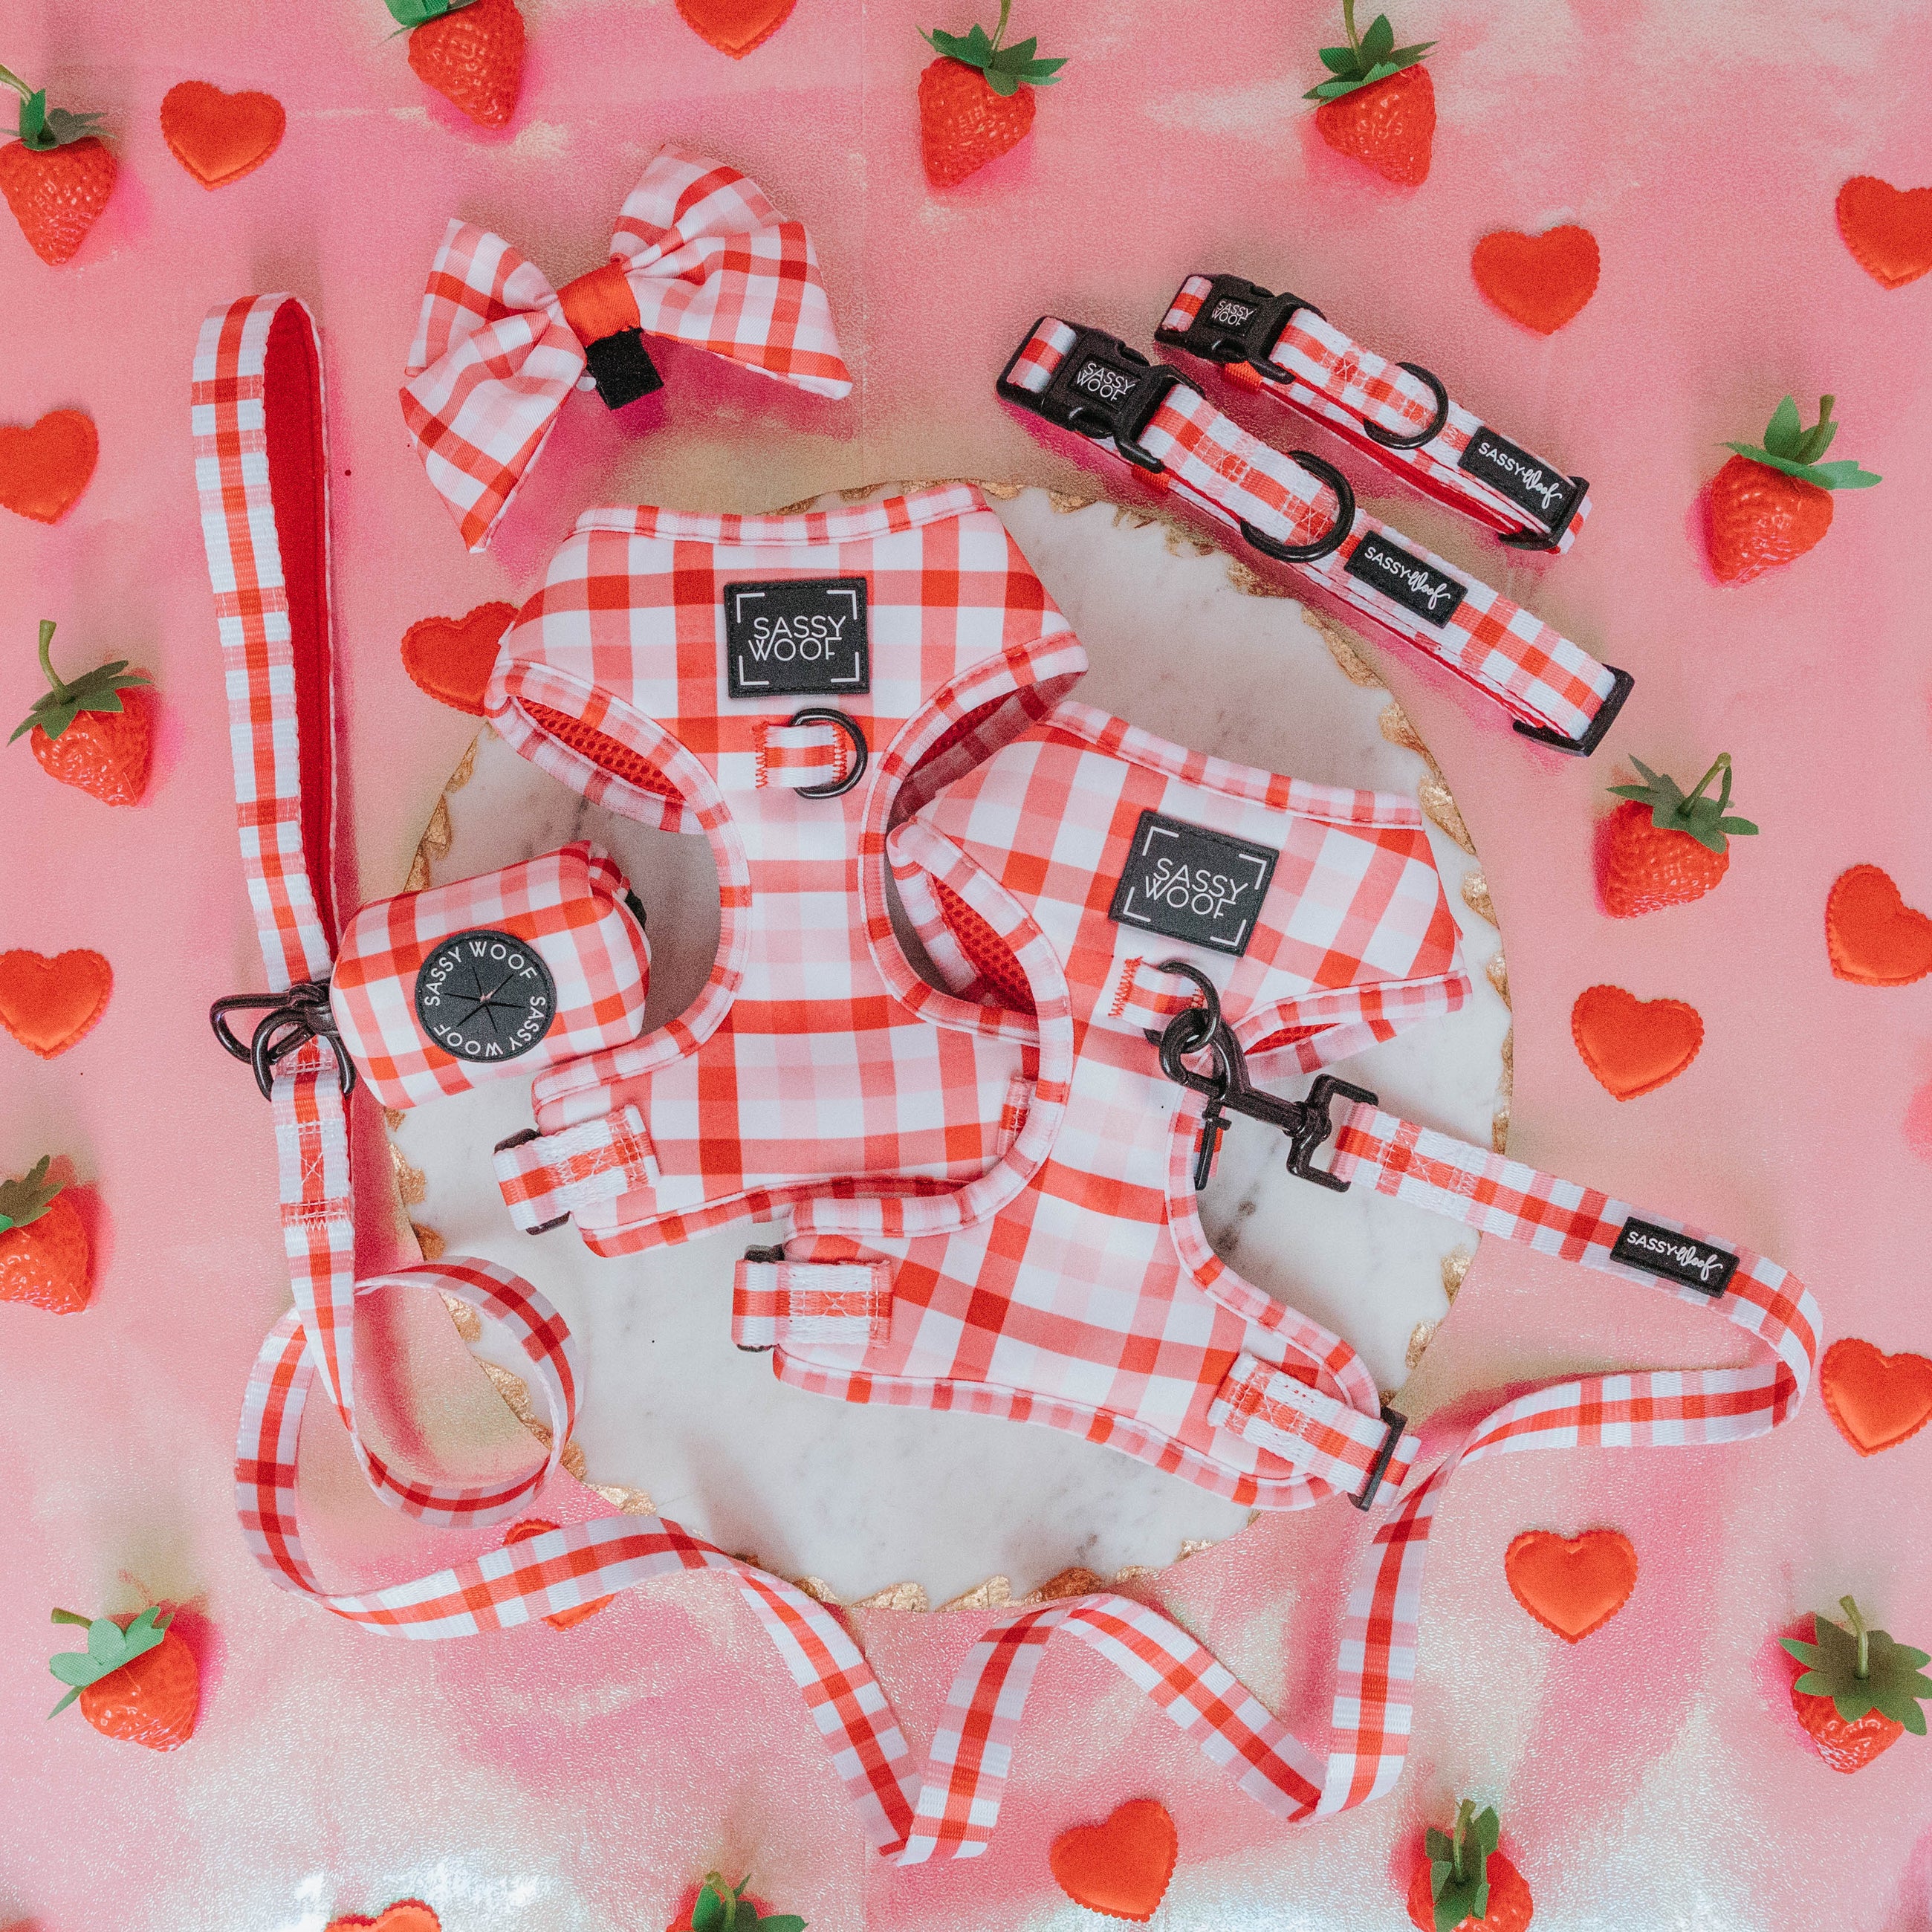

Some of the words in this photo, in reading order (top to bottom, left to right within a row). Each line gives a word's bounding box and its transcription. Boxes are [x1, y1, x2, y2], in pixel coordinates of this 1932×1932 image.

[1211, 308, 1247, 326] WOOF
[1217, 300, 1254, 319] SASSY
[1077, 371, 1126, 401] WOOF
[1083, 363, 1135, 392] SASSY
[1478, 442, 1525, 476] SASSY
[1522, 468, 1563, 510] Woof
[1364, 546, 1411, 578] SASSY
[1407, 570, 1451, 610] Woof
[753, 615, 846, 640] SASSY
[748, 637, 843, 661] WOOF
[1145, 875, 1236, 919] WOOF
[1153, 858, 1249, 901] SASSY
[424, 946, 462, 1006] SASSY
[469, 941, 538, 979] WOOF
[432, 1024, 504, 1057] WOOF
[509, 996, 546, 1051] SASSY
[1627, 1231, 1677, 1256] SASSY
[1674, 1245, 1723, 1281] Woof
